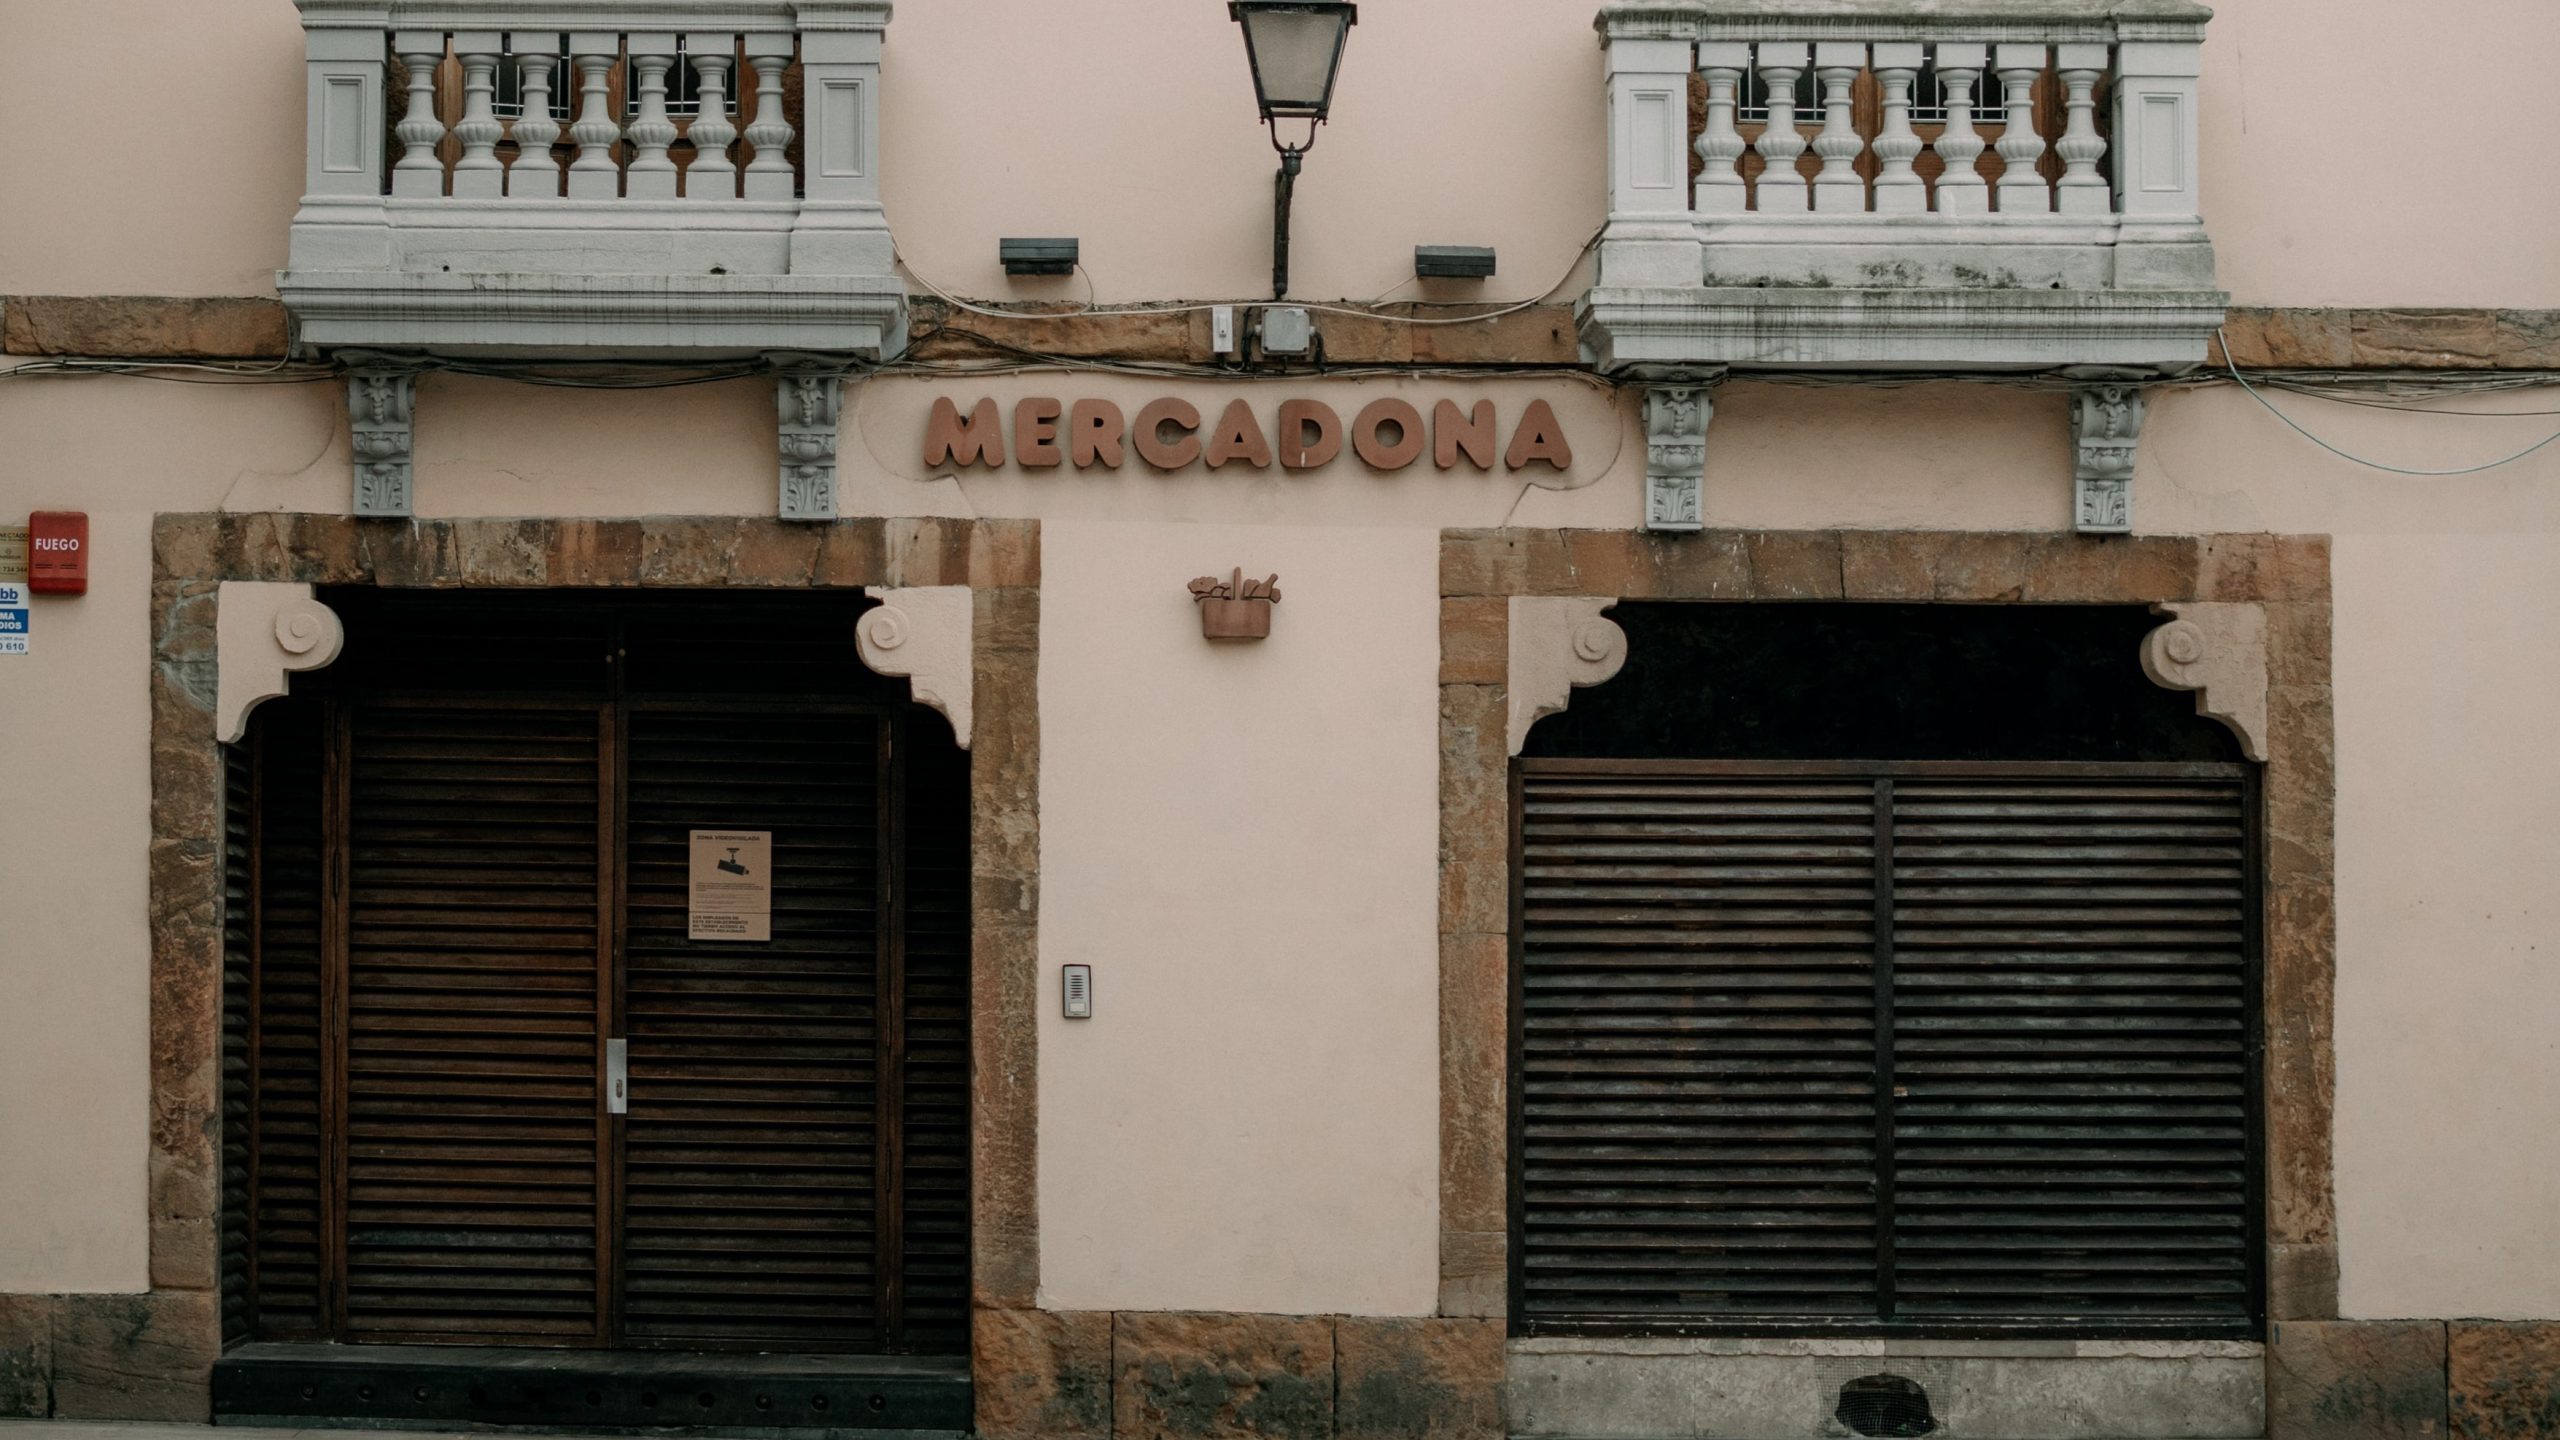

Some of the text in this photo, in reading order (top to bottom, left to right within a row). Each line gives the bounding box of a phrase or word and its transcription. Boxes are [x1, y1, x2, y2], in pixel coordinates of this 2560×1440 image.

[923, 396, 1573, 471] MERCADONA
[35, 537, 79, 551] FUEGO
[6, 642, 24, 651] 610
